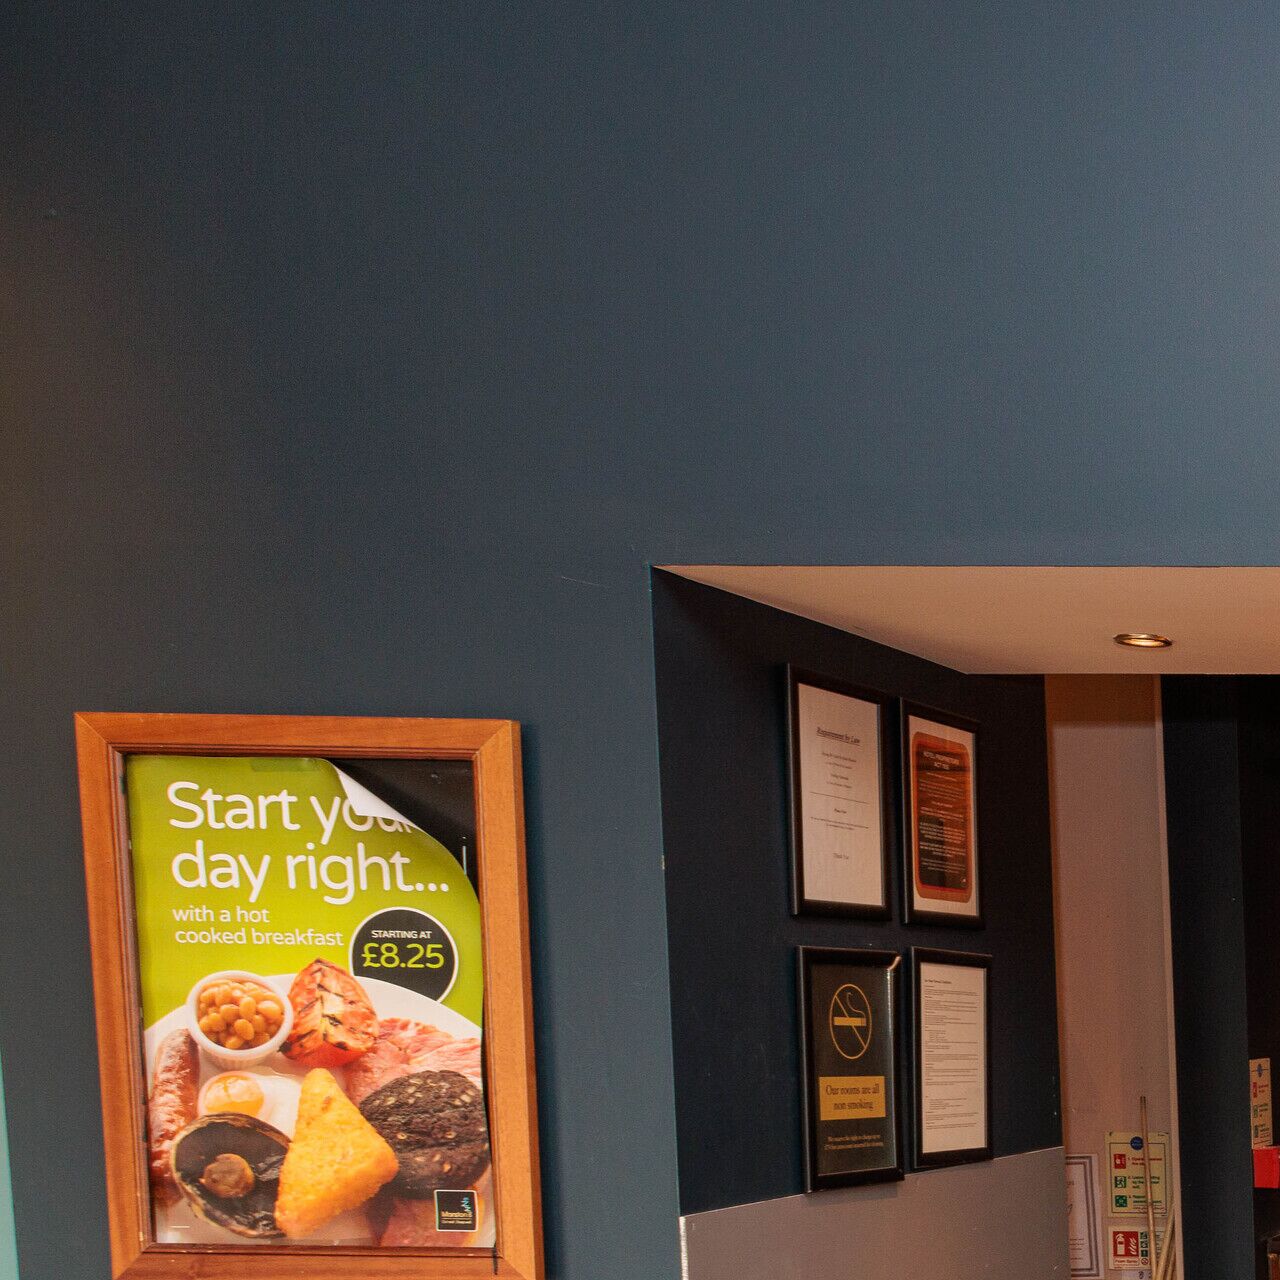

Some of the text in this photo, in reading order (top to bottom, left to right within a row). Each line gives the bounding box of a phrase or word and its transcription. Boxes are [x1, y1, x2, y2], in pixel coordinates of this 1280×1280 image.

[167, 781, 300, 831] Start
[171, 839, 449, 905] day right...
[172, 905, 270, 923] with a hot
[175, 928, 344, 946] cooked breakfast
[371, 930, 432, 939] STARTING AT
[361, 942, 445, 969] £8.25
[825, 1083, 880, 1095] Our rooms are all
[833, 1102, 846, 1110] non
